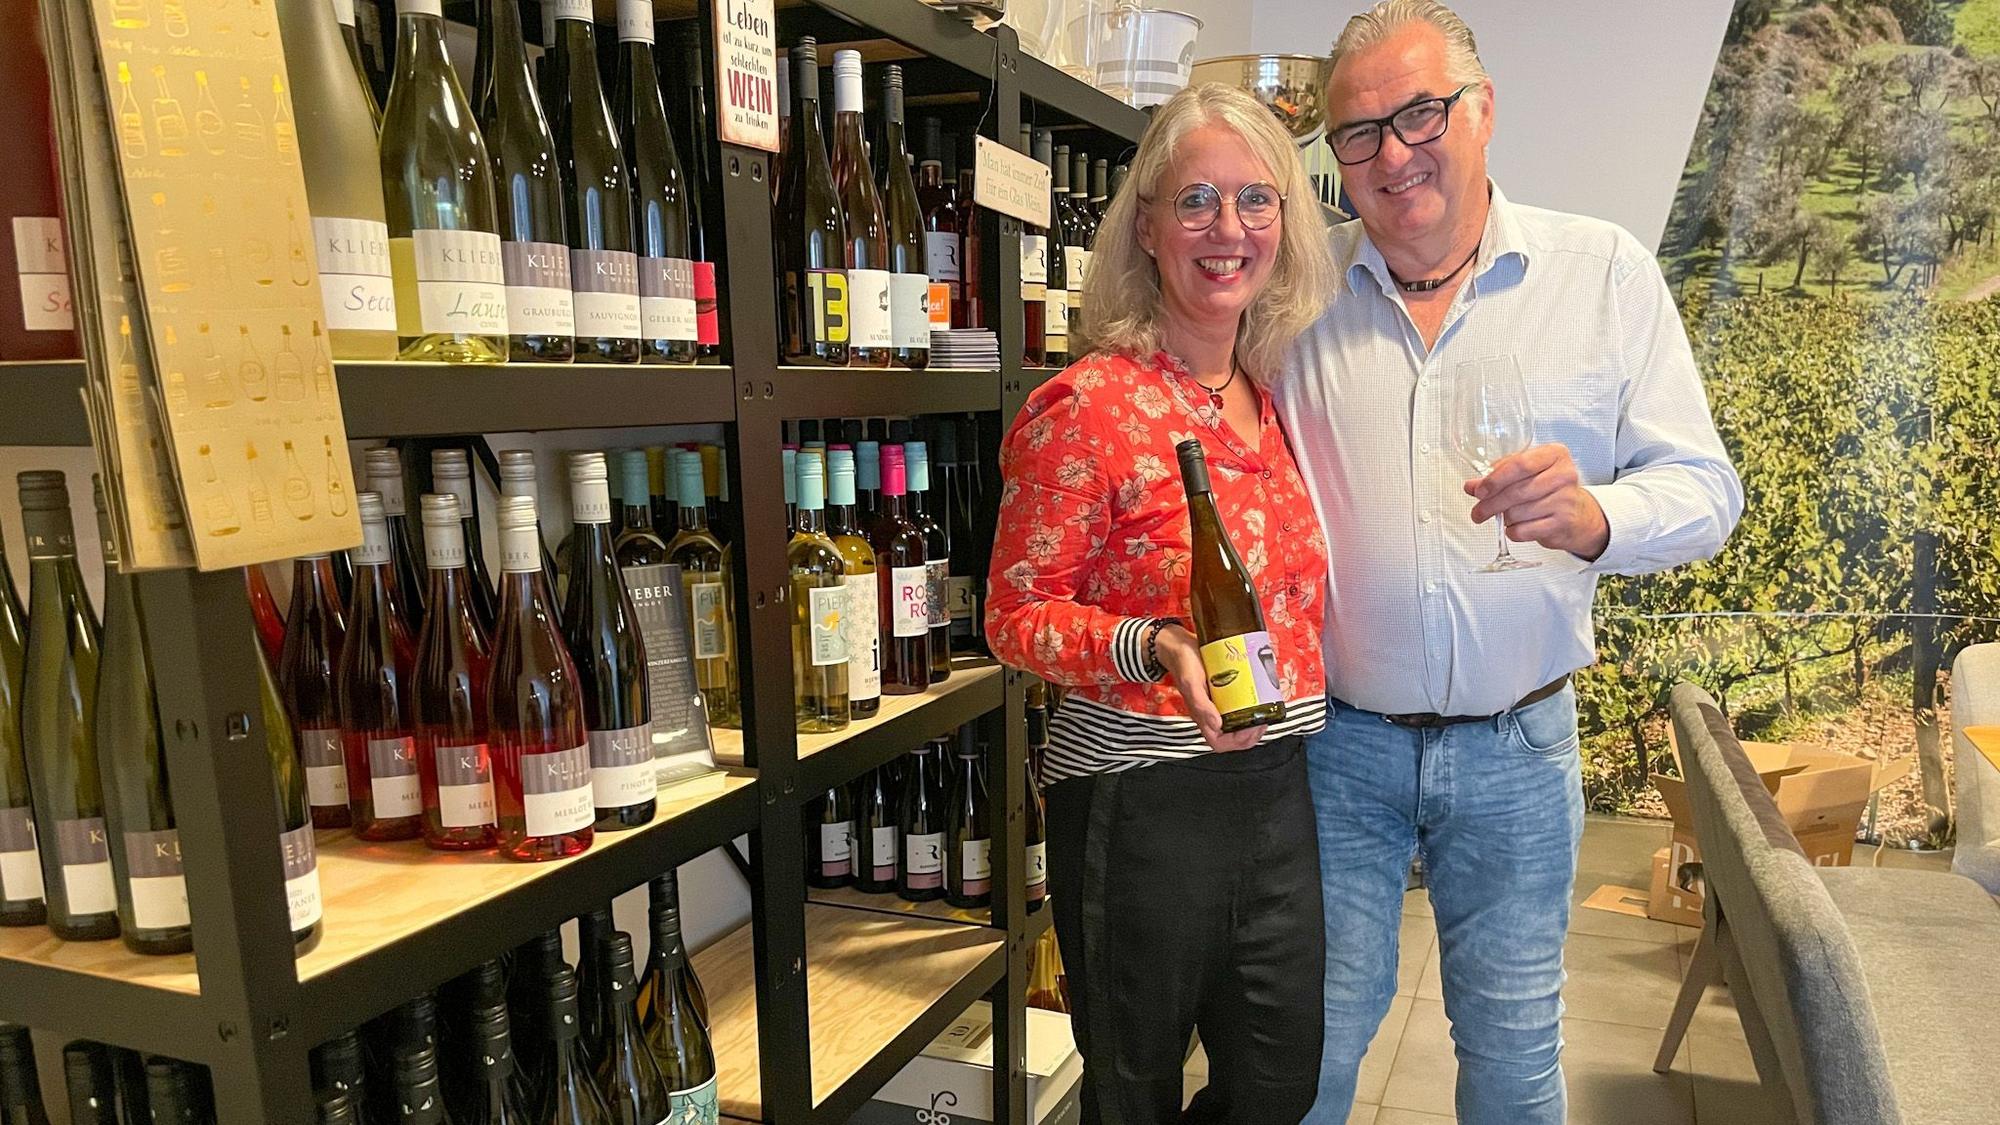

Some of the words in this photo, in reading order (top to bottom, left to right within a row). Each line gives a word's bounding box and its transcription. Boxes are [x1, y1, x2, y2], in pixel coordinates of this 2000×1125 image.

[727, 0, 769, 38] Leben
[730, 51, 768, 75] schlechten
[727, 68, 773, 115] WEIN
[982, 151, 999, 173] Man
[1000, 160, 1011, 178] hat
[807, 272, 849, 343] 13
